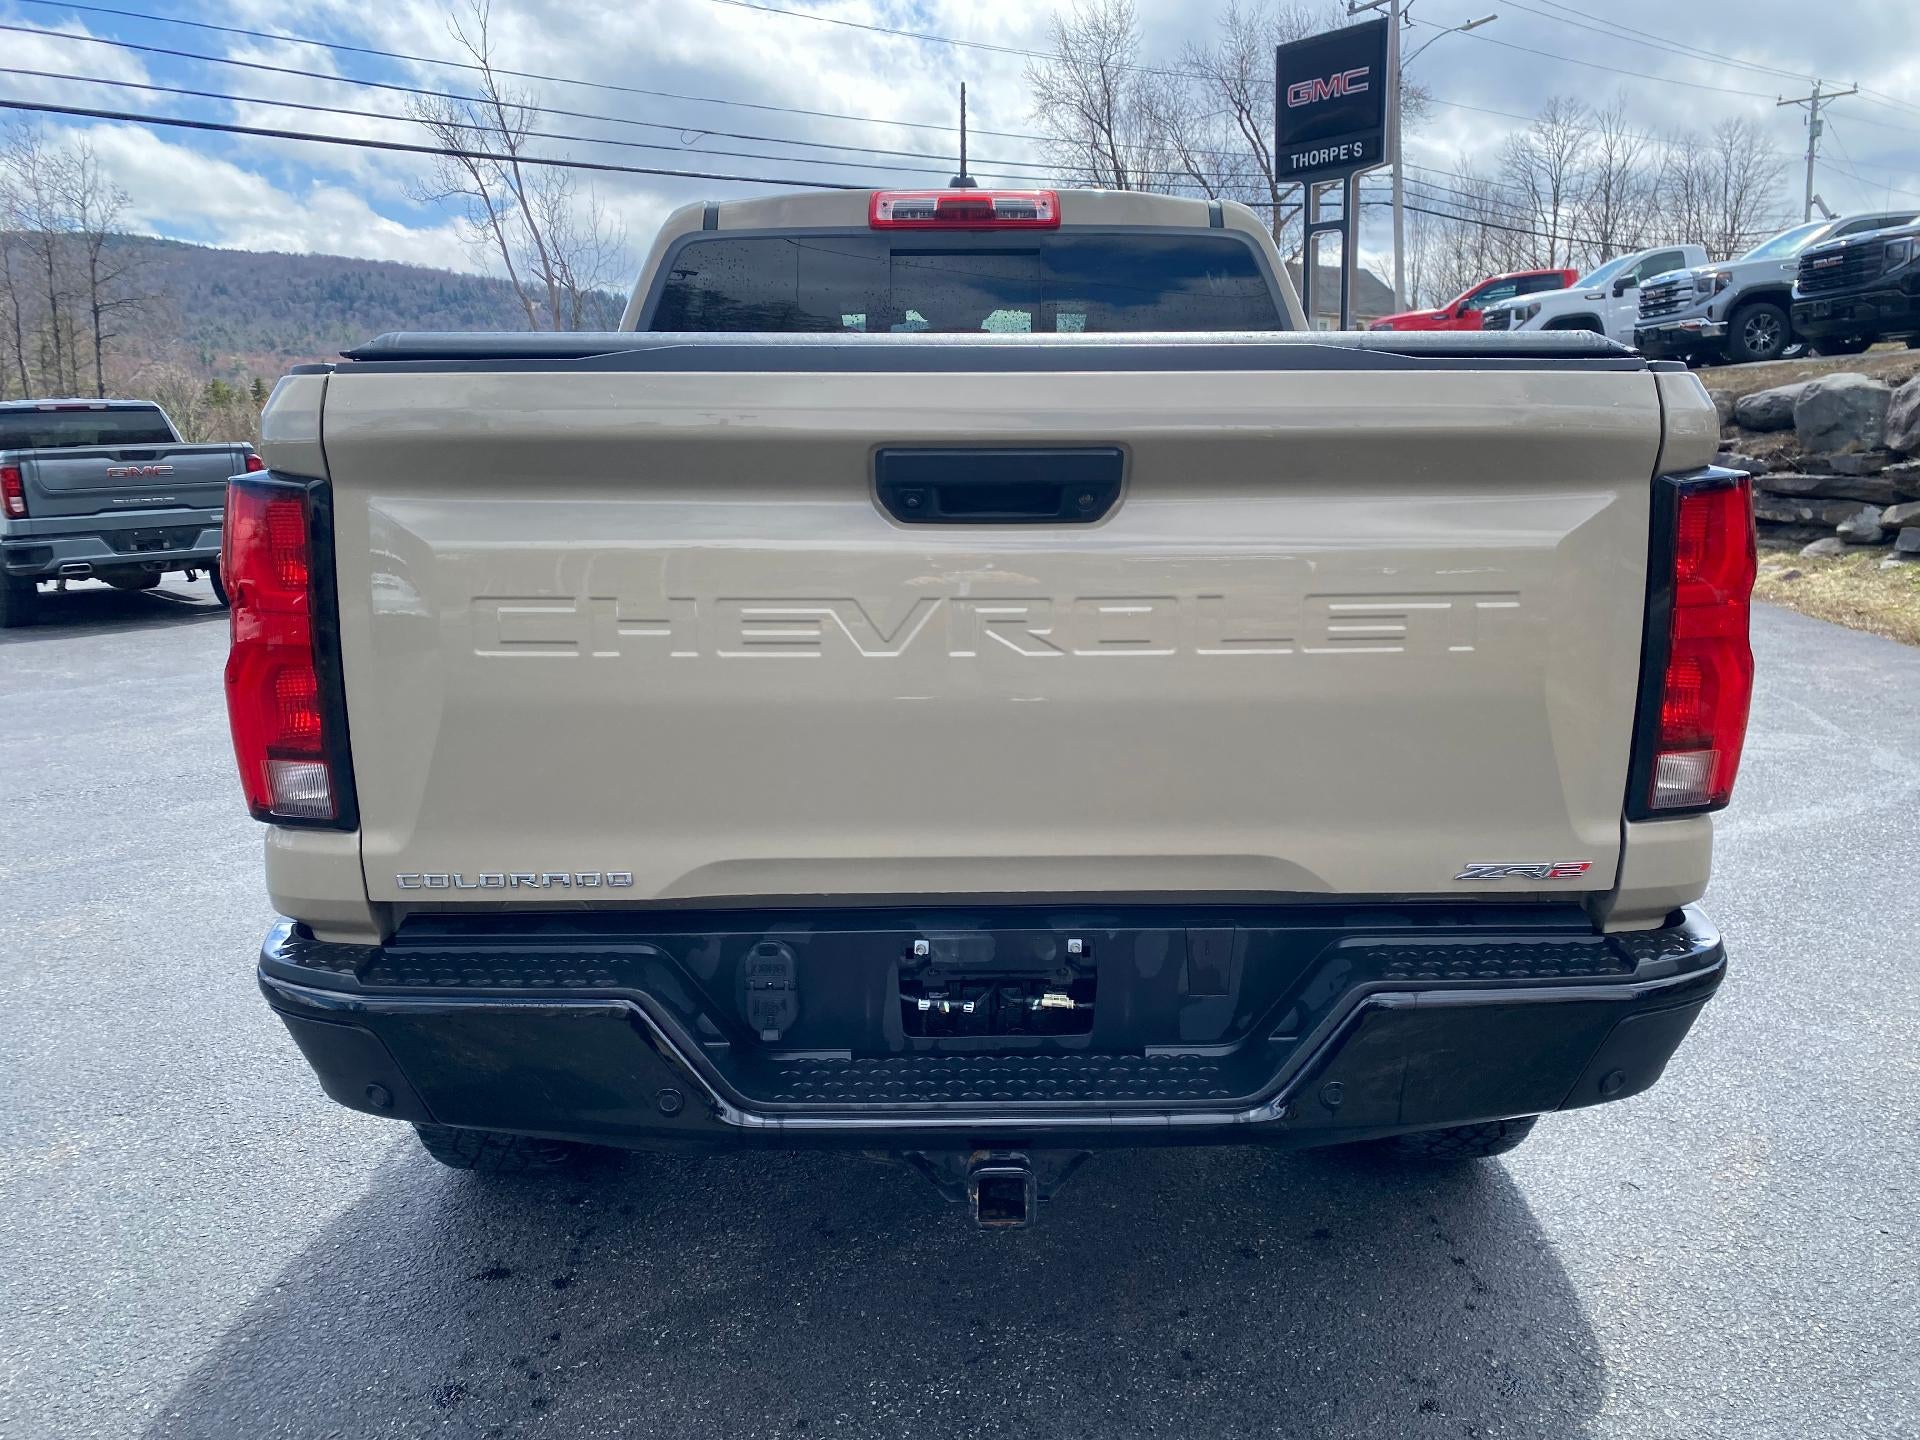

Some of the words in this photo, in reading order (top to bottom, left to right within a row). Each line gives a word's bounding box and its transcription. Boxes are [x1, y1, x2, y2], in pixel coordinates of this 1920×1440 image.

[1287, 66, 1370, 108] GMC
[1290, 141, 1364, 169] THORPE'S
[106, 465, 175, 479] GMC
[471, 591, 1521, 658] CHEVROLET
[395, 871, 634, 888] COLORADO
[1454, 860, 1593, 881] ZR2
